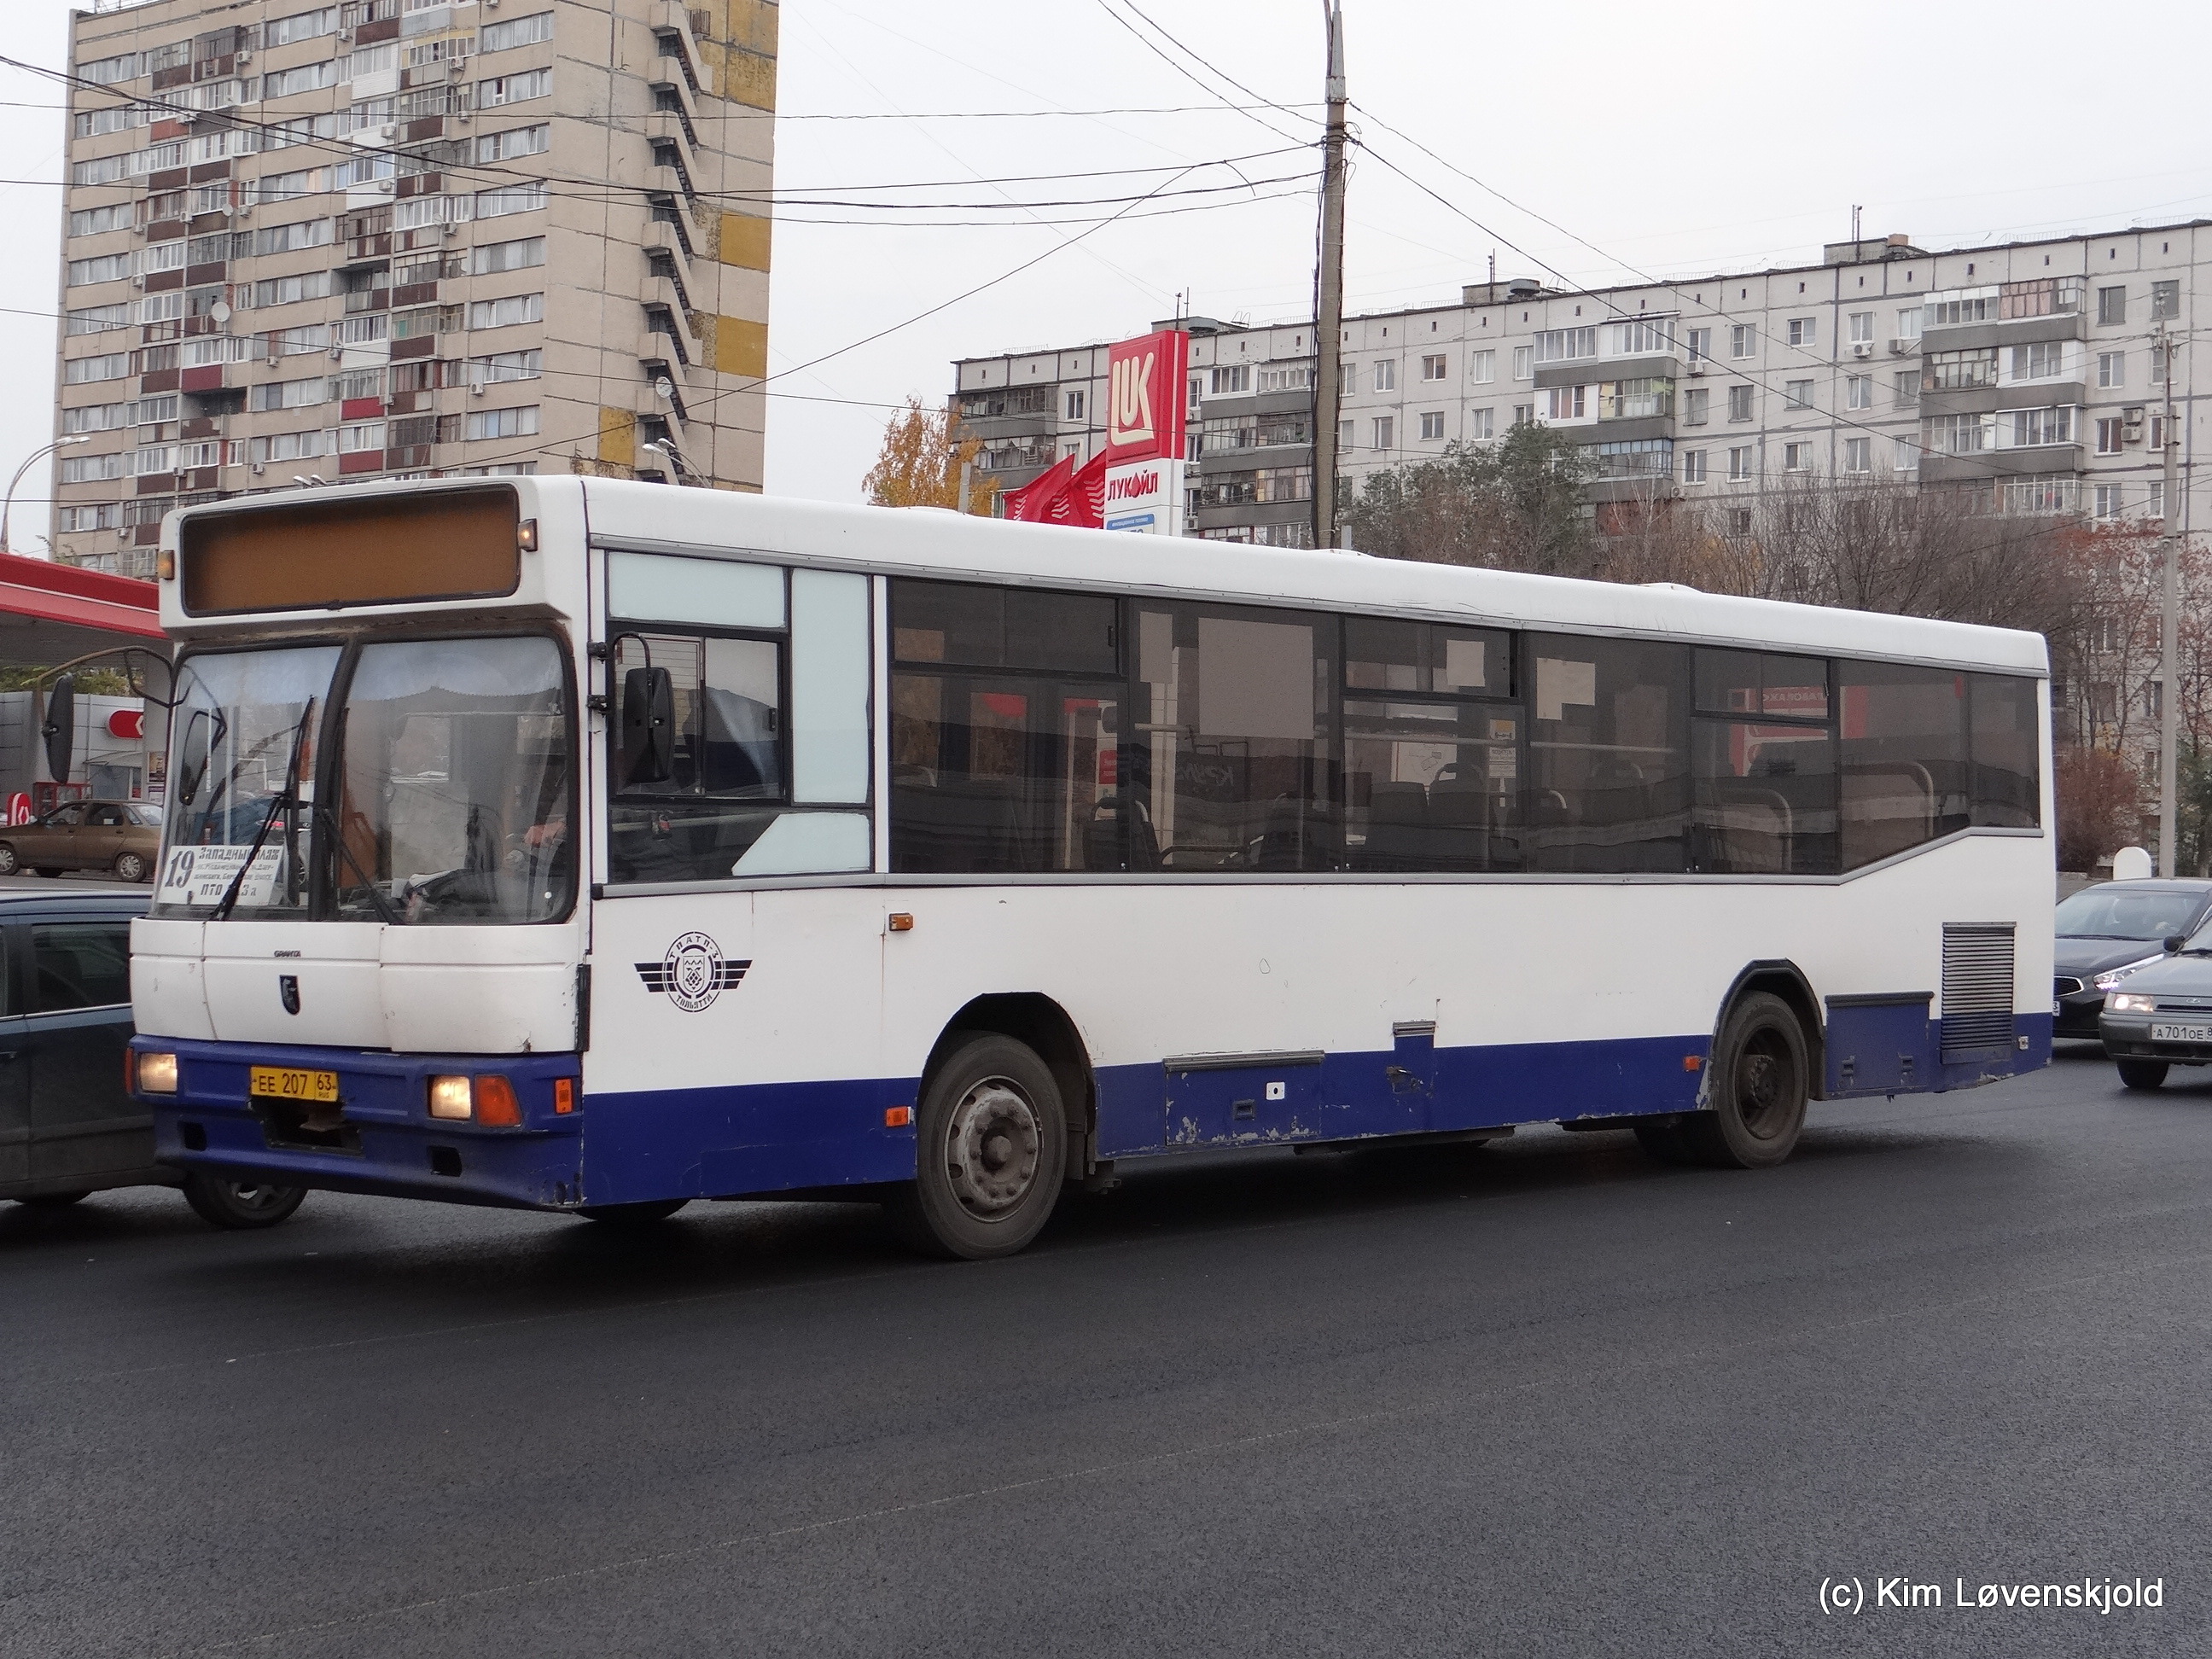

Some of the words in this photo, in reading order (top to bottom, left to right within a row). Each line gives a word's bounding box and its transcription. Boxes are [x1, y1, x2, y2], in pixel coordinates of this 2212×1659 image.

[165, 850, 195, 888] 19
[676, 993, 713, 1009] ТОЛЬЯТТИ
[282, 1073, 308, 1094] 207
[317, 1074, 332, 1091] 63
